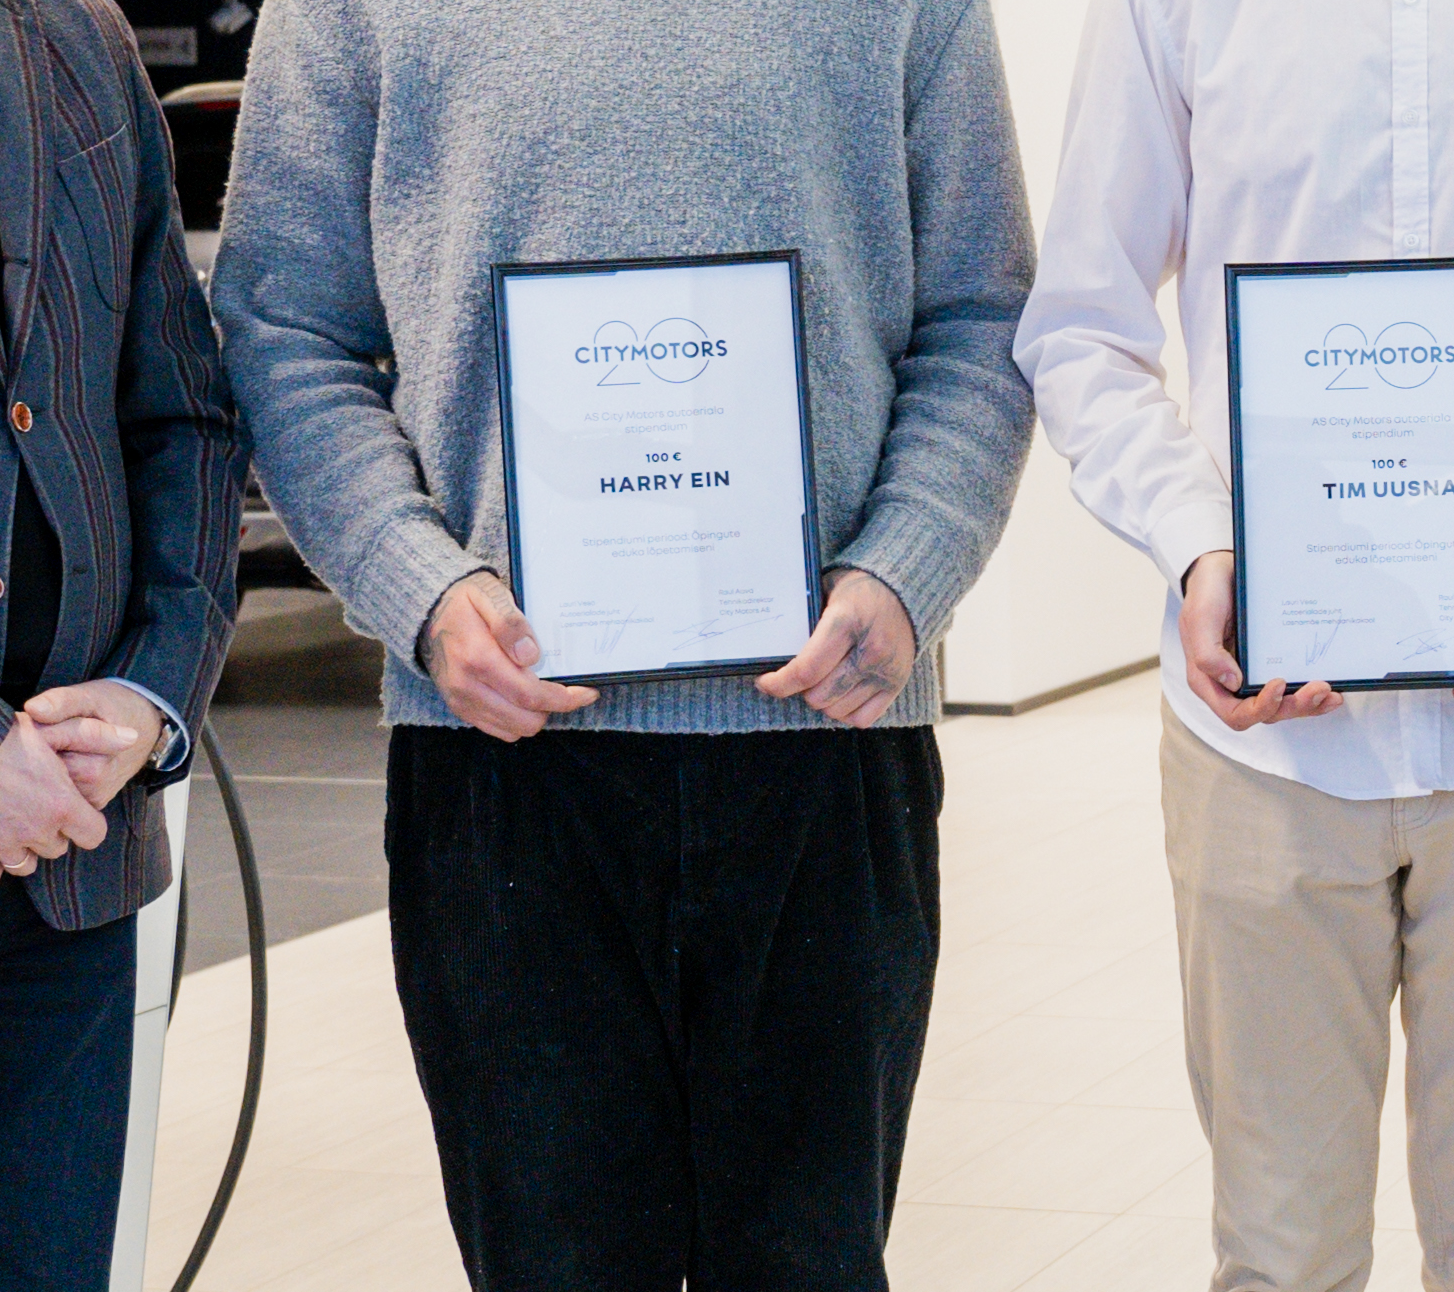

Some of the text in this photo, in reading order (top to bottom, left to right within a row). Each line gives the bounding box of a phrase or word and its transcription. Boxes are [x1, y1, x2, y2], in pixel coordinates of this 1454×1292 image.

[575, 339, 728, 364] CITYMOTORS
[584, 413, 600, 422] AS
[601, 411, 624, 423] City
[626, 410, 665, 420] Motors
[1311, 417, 1327, 426] AS
[1329, 416, 1352, 428] City
[1353, 415, 1392, 425] Motors
[624, 422, 688, 435] stipendium
[1351, 428, 1415, 440] stipendium
[645, 451, 682, 463] 100 €
[1371, 458, 1408, 469] 100 €
[600, 470, 730, 493] HARRY EIN
[1322, 482, 1366, 499] TIM
[582, 535, 646, 548] Stipendiumi
[691, 530, 741, 542] Õpingute
[611, 544, 715, 558] eduka lõpetamiseni
[1306, 542, 1369, 554] Stipendiumi
[1335, 553, 1438, 565] eduka lõpetamiseni
